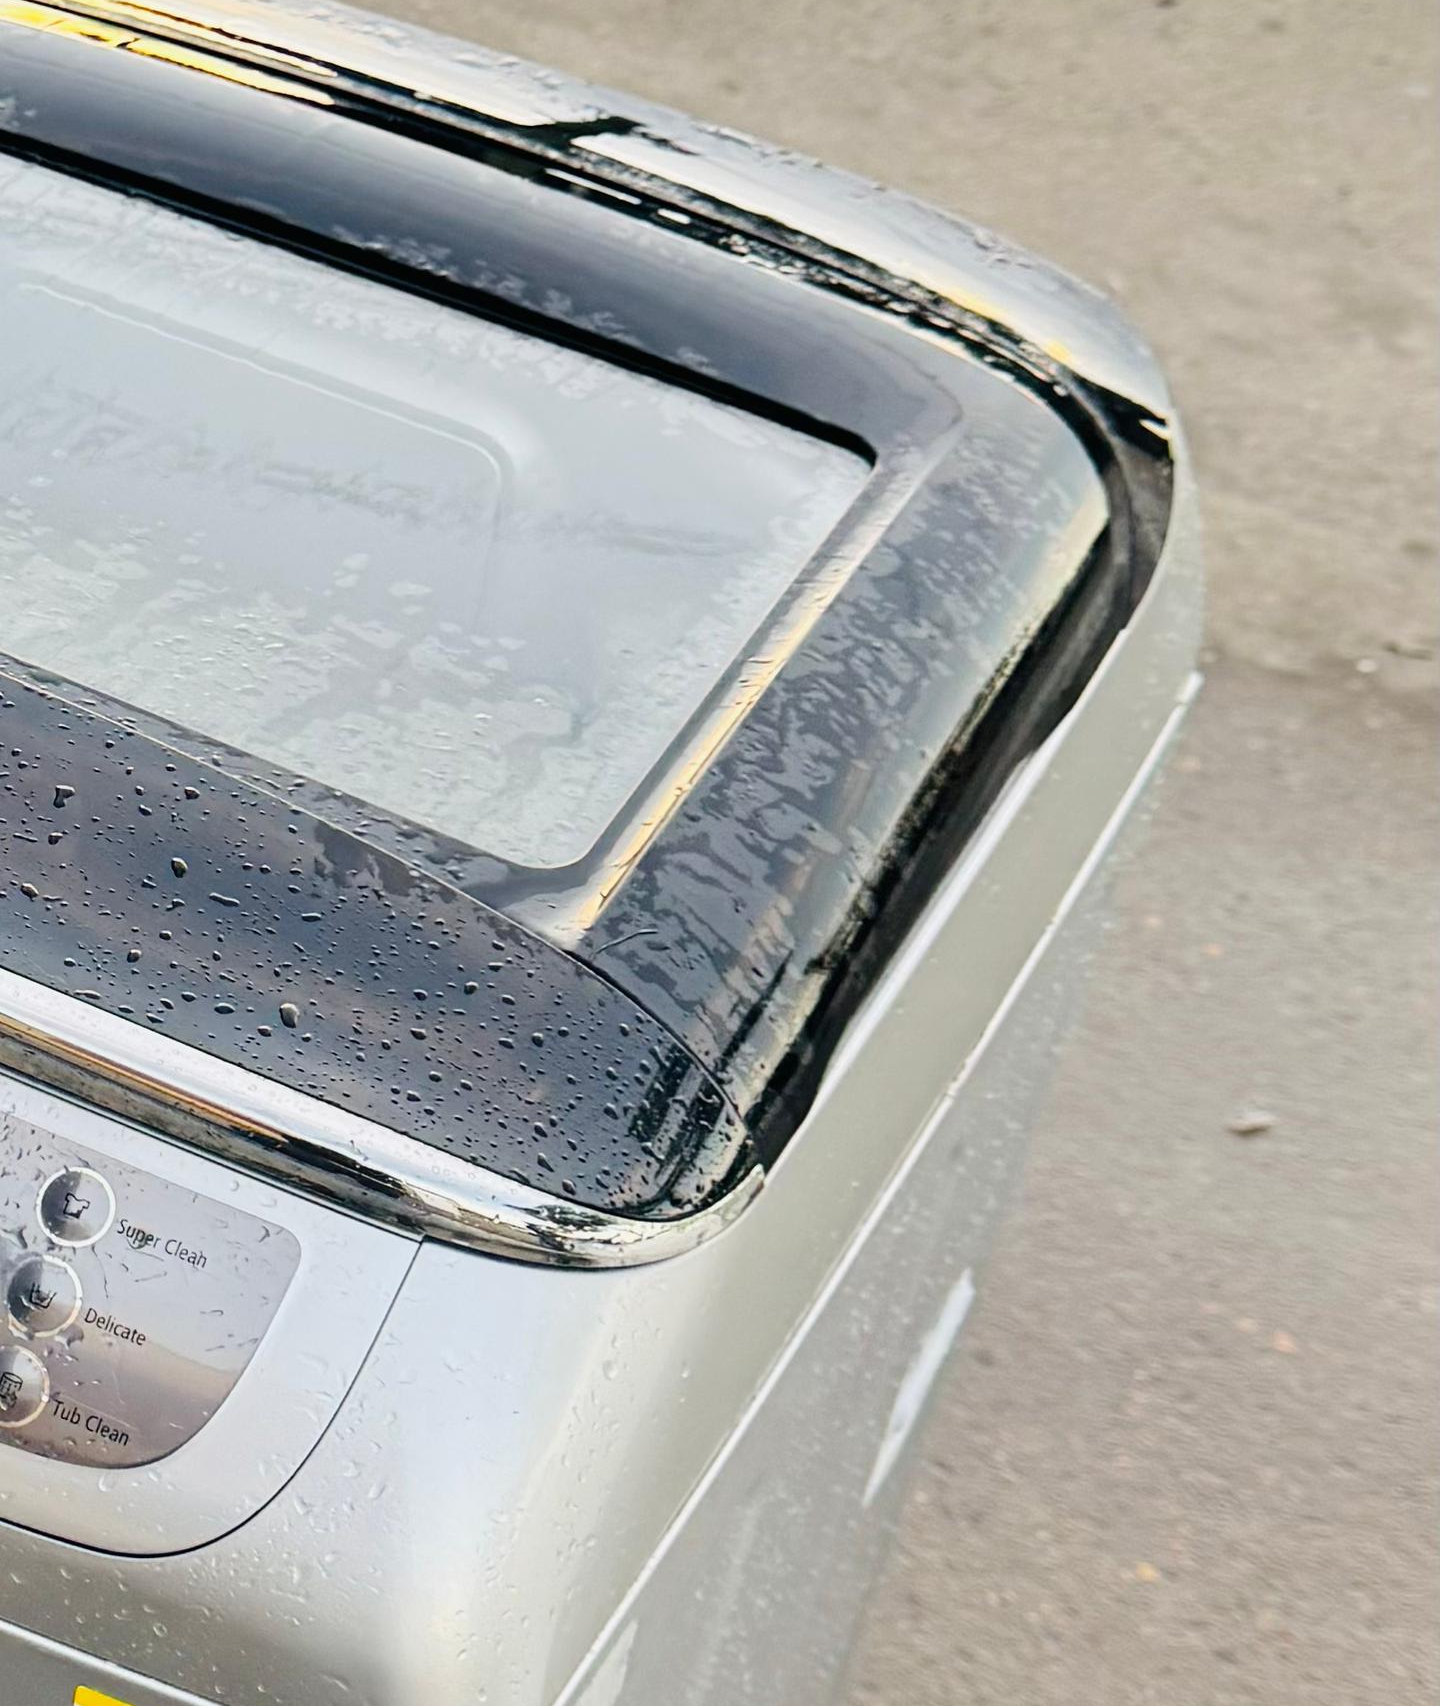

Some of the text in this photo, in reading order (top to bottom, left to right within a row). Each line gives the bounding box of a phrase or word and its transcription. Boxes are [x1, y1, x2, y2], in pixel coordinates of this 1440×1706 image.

[116, 1219, 209, 1269] Super Clean
[84, 1307, 148, 1347] Delicate
[52, 1400, 130, 1447] Tub Clean
